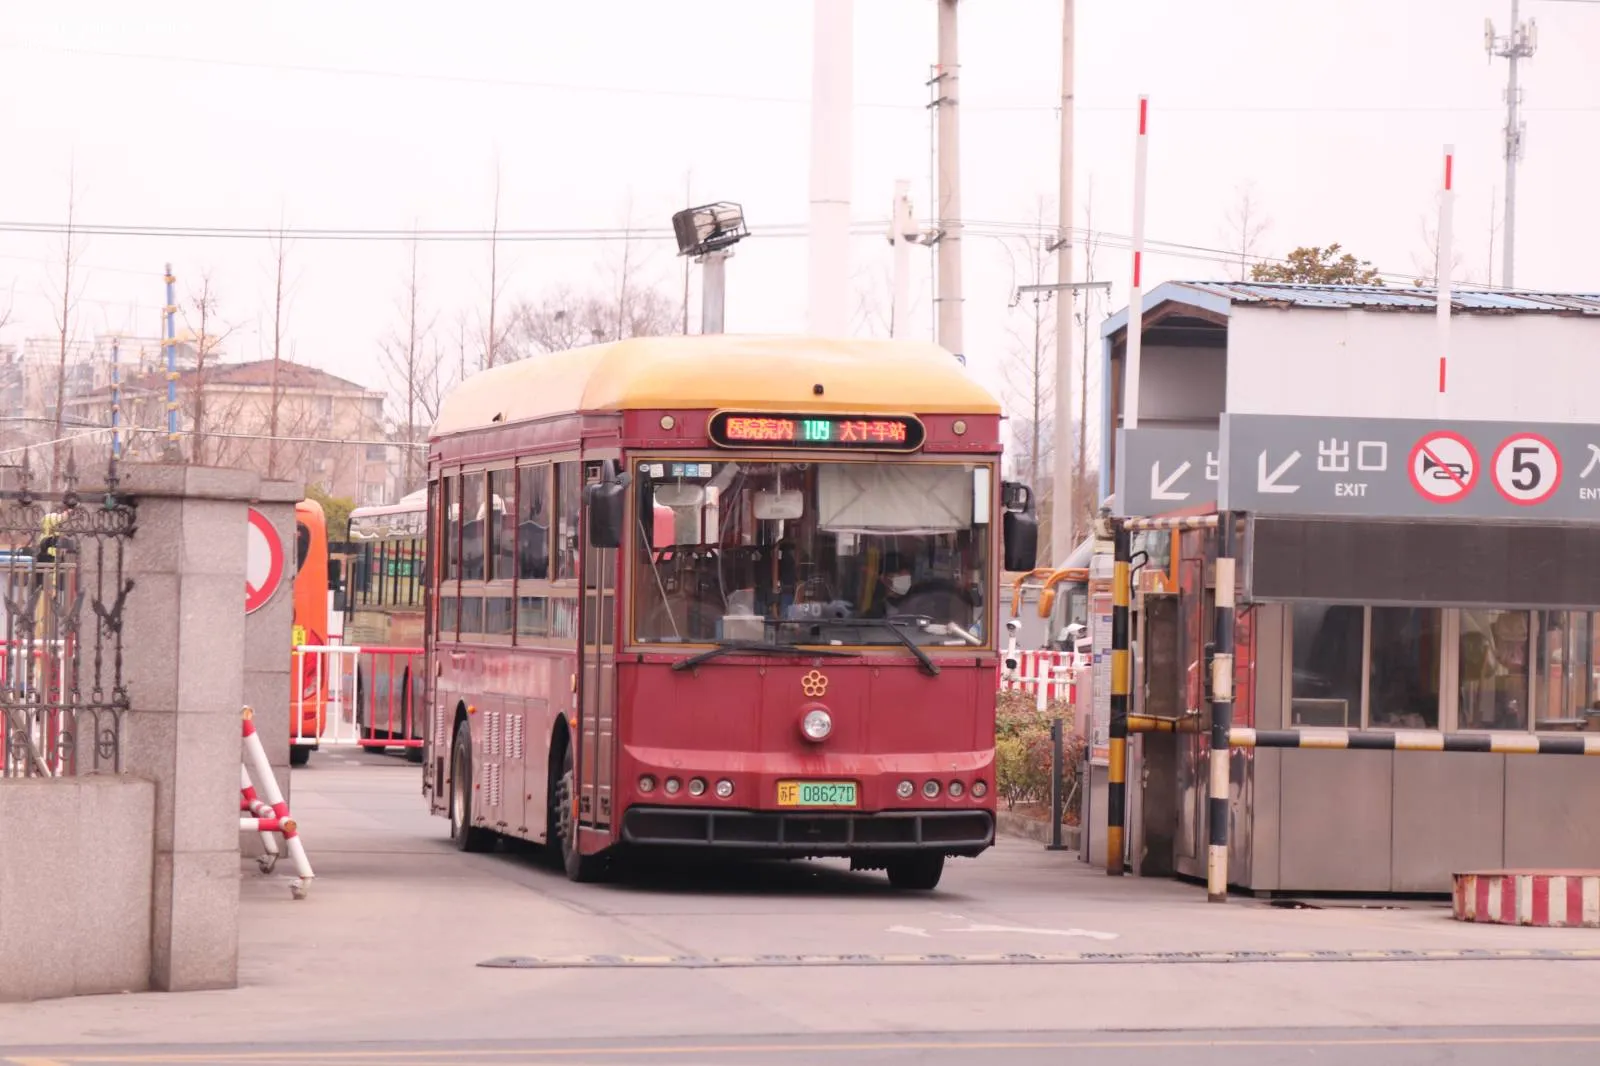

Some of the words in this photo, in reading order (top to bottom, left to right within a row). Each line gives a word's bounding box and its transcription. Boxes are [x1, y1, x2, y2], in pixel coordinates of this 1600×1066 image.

[1318, 437, 1388, 472] 出口
[1511, 447, 1541, 491] 5
[1335, 483, 1368, 497] EXIT
